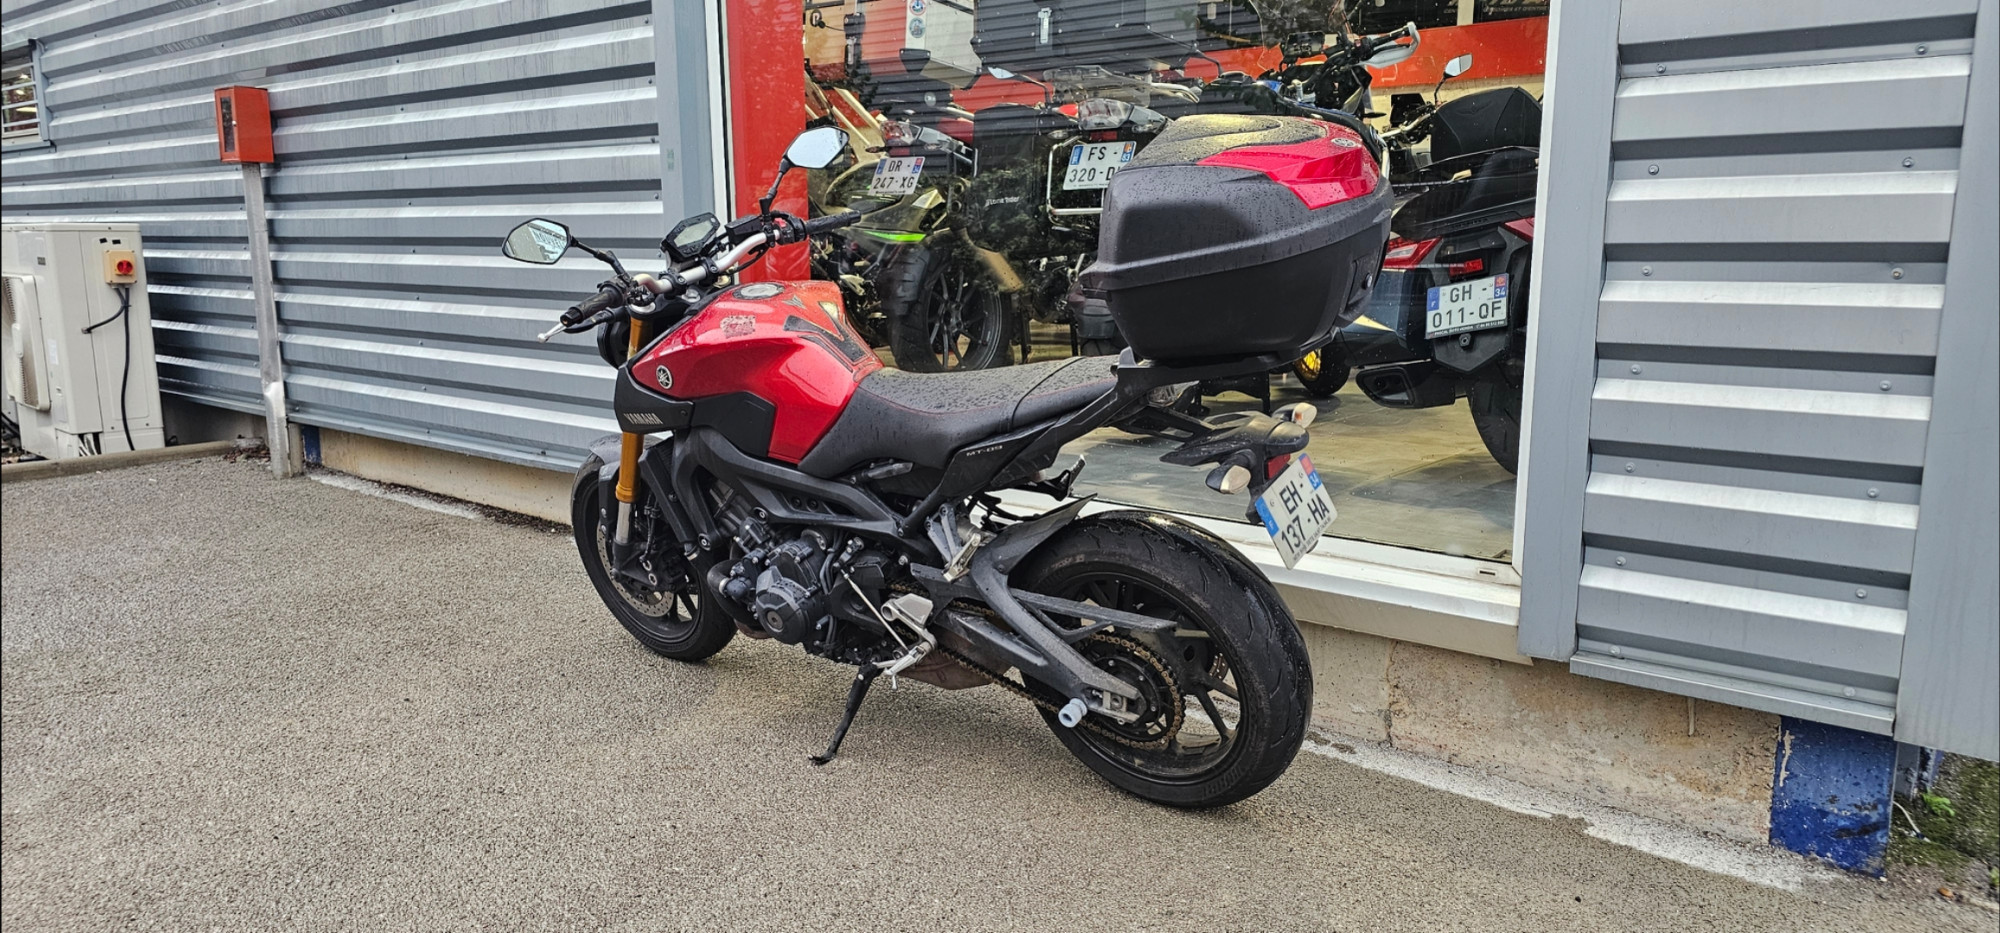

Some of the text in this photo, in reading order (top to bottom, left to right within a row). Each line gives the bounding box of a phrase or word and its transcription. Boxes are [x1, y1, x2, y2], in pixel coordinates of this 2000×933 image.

[1088, 146, 1107, 161] FS
[888, 160, 903, 172] DR
[1450, 284, 1472, 303] GH
[1495, 287, 1506, 297] 34
[623, 412, 664, 425] YAMAHA
[966, 445, 1003, 457] MT-09
